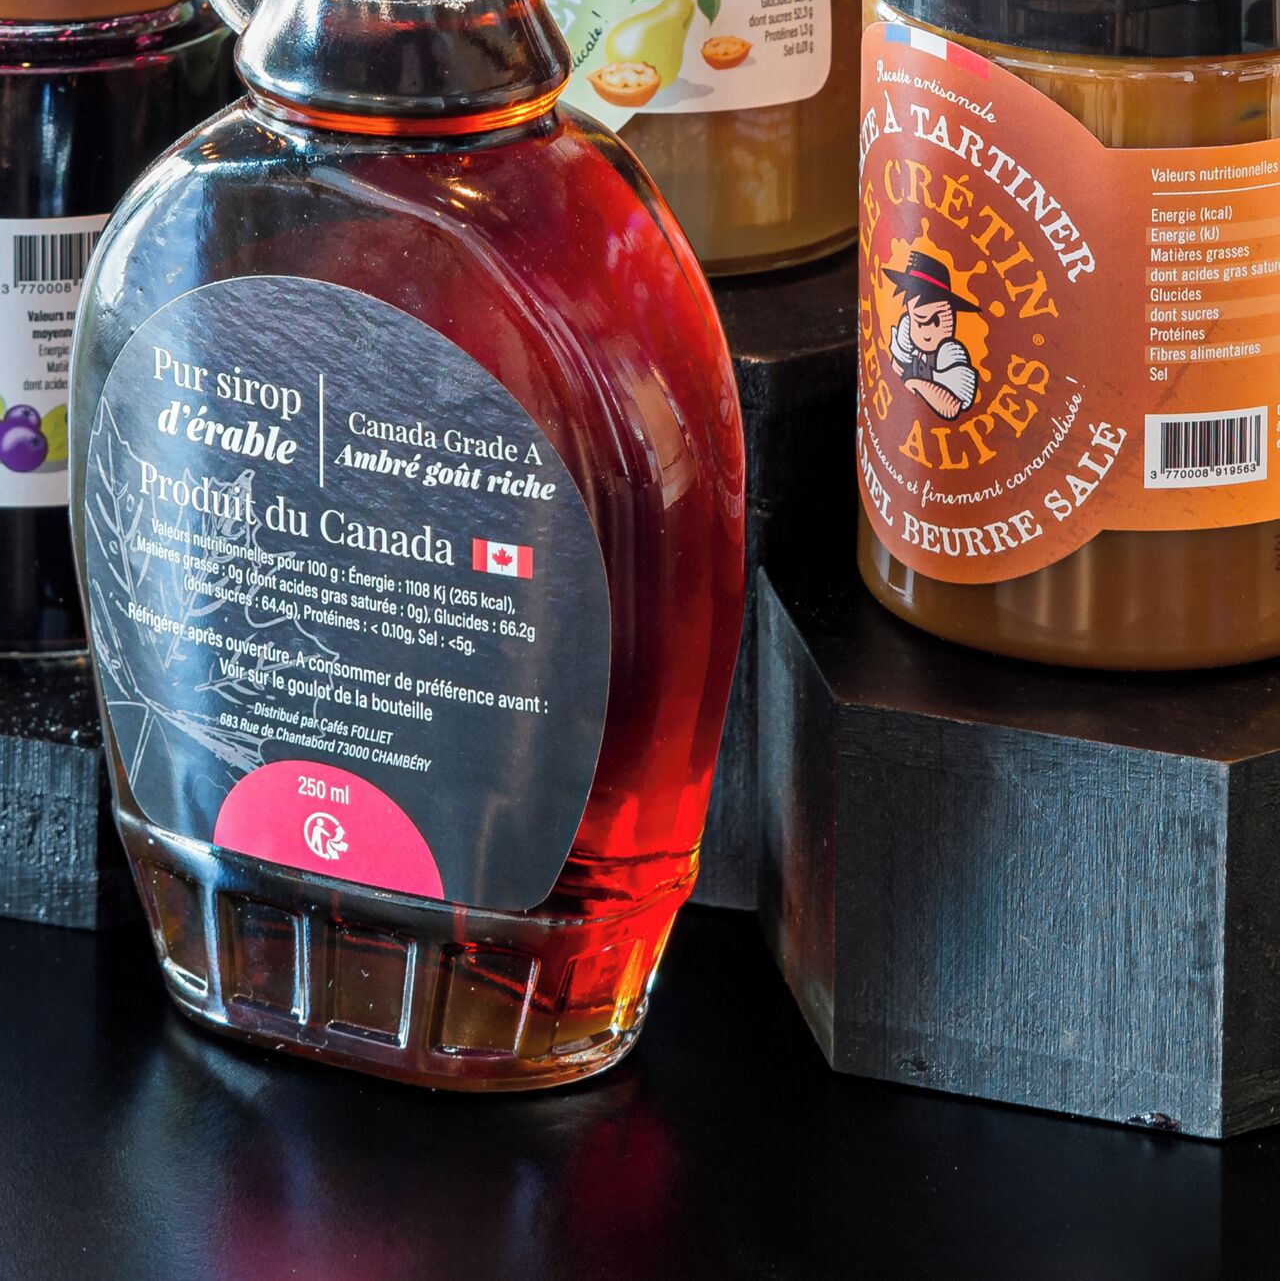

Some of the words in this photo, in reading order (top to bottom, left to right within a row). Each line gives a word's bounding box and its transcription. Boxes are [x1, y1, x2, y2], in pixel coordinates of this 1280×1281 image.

[749, 15, 767, 28] dont
[877, 59, 912, 84] Recette
[914, 77, 996, 123] artisanale
[910, 103, 1096, 284] TARTINER
[1151, 168, 1196, 183] Valeurs
[1199, 160, 1279, 181] nutritionnelles
[1150, 228, 1196, 244] Energie
[1200, 225, 1220, 242] (kJ)
[1151, 208, 1196, 224] Energie
[1200, 205, 1233, 222] (kcal)
[884, 159, 1059, 319] CRÉTIN
[1150, 247, 1202, 262] Matières
[1206, 244, 1250, 263] grasses
[1, 283, 10, 295] 3
[20, 283, 72, 295] 770008
[1150, 267, 1177, 282] dont
[1181, 264, 1220, 281] acides
[1223, 264, 1248, 281] gras
[1150, 287, 1202, 302] Glucides
[27, 310, 64, 323] Valeurs
[1150, 307, 1177, 322] dont
[1181, 308, 1219, 321] sucres
[1150, 326, 1206, 341] Protéines
[860, 293, 893, 420] DES
[1149, 367, 1168, 381] Sel
[1150, 346, 1186, 361] Fibres
[1190, 342, 1261, 360] alimentaires
[153, 346, 208, 392] Pur
[217, 367, 301, 421] sirop
[157, 401, 297, 464] d'érable
[898, 354, 1050, 470] ALPES
[348, 412, 437, 449] Canada
[443, 429, 518, 462] Grade
[523, 442, 543, 466] A
[334, 444, 421, 479] Ambré
[422, 462, 482, 490] goût
[486, 470, 556, 500] riche
[901, 510, 1043, 557] BEURRE
[1043, 421, 1127, 522] SALÉ
[921, 479, 1003, 508] finement
[1165, 468, 1209, 480] 770008
[1216, 463, 1257, 477] 919563
[139, 461, 257, 525] Produit
[265, 496, 309, 537] du
[320, 509, 455, 566] Canada
[137, 537, 181, 563] Matières
[183, 554, 219, 575] grasse
[245, 567, 277, 590] (dont
[279, 577, 318, 599] acides
[321, 588, 347, 605] gras
[350, 593, 397, 616] saturée
[434, 608, 489, 632] Glucides
[499, 620, 536, 642] 66.2g
[151, 518, 191, 544] Valeurs
[193, 533, 274, 566] nutritionnelles
[277, 556, 305, 575] pour
[307, 559, 327, 577] 100
[348, 565, 395, 593] Énergie
[405, 579, 430, 598] 1108
[449, 586, 478, 607] (265
[481, 592, 516, 615] kcal),
[184, 574, 214, 596] (dont
[214, 584, 252, 606] sucres
[303, 605, 361, 632] Protéines
[418, 631, 438, 647] Sel
[128, 602, 185, 635] Réfrigérer
[188, 627, 223, 648] après
[225, 636, 293, 665] ouverture.
[308, 657, 391, 687] consommer
[394, 672, 412, 691] de
[416, 678, 494, 706] préférence
[498, 694, 540, 713] avant
[219, 657, 245, 679] Voir
[248, 669, 269, 685] sur
[288, 677, 331, 701] goulot
[334, 686, 352, 705] de
[372, 693, 433, 722] bouteille
[240, 718, 259, 734] Rue
[276, 727, 335, 752] Chantabord
[336, 741, 370, 760] 73000
[372, 749, 432, 773] CHAMBÉRY
[253, 702, 299, 724] Distribué
[320, 718, 349, 736] Cafés
[351, 724, 394, 745] FOLLIET
[297, 775, 326, 799] 250
[330, 785, 349, 805] ml
